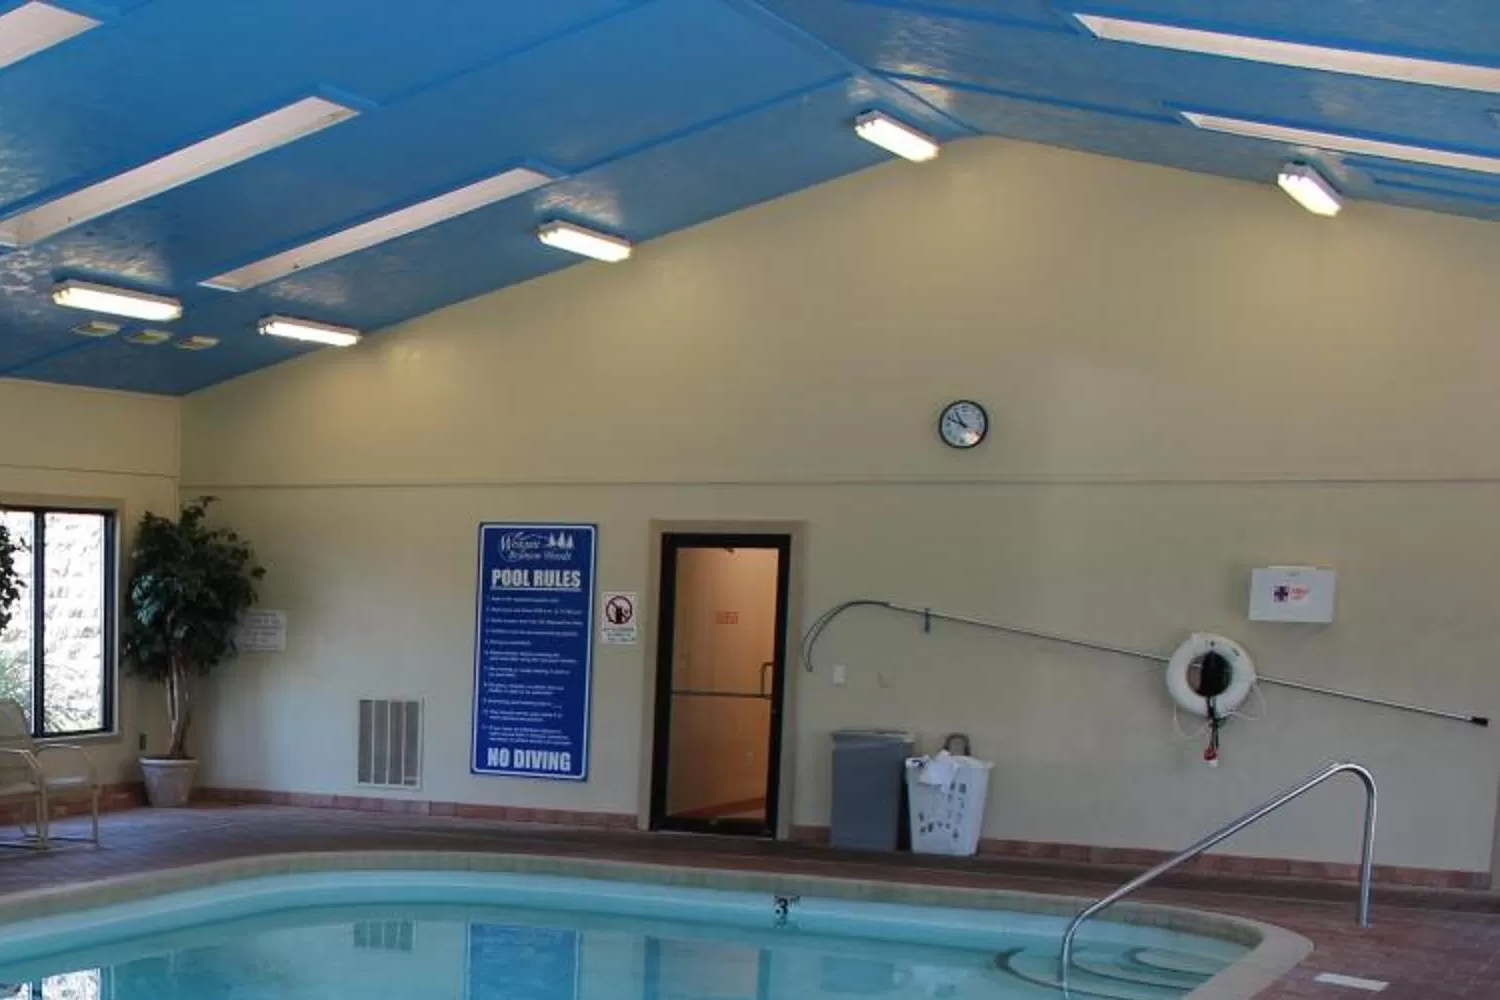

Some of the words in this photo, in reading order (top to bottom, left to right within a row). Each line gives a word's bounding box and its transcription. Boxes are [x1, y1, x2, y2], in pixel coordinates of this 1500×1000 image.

[491, 568, 530, 587] POOL
[533, 569, 581, 588] RULES
[487, 747, 510, 768] NO
[513, 749, 571, 772] DIVING
[774, 897, 789, 916] 3
